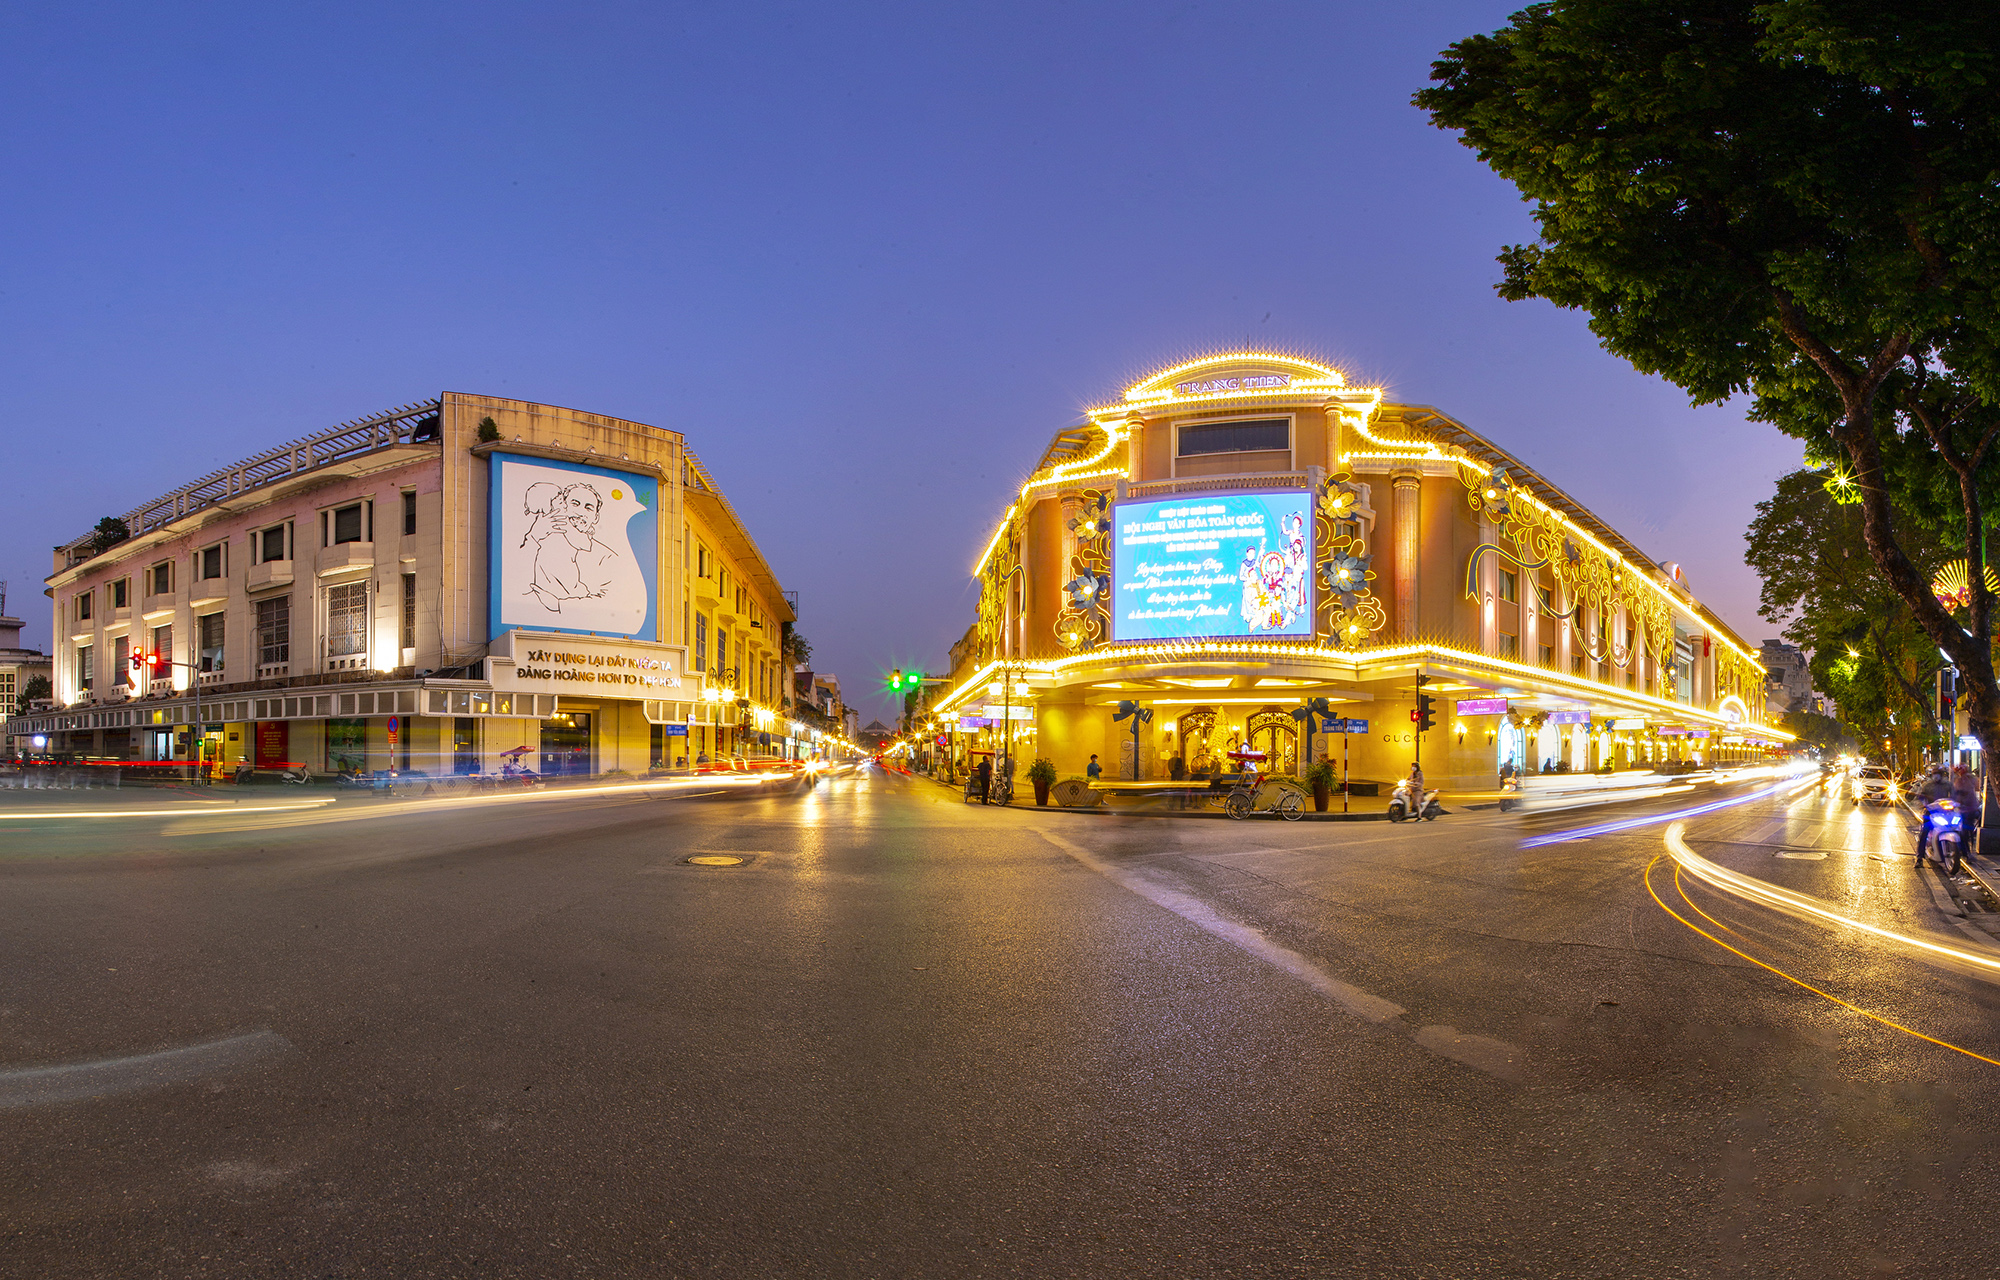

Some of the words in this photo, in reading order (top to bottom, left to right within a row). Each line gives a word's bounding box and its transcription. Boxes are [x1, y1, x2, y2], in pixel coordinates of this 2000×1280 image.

[1176, 377, 1240, 394] TRANG
[1242, 375, 1291, 389] TIEN
[1123, 521, 1141, 534] HỘI
[1142, 521, 1166, 533] NGHỊ
[1167, 518, 1186, 530] VĂN
[1187, 516, 1208, 528] HÓA
[1208, 514, 1235, 527] TOÀN
[1236, 512, 1264, 526] QUỐC
[528, 649, 552, 662] XÂY
[554, 652, 586, 665] DỤNG
[589, 654, 604, 667] LẠI
[606, 653, 627, 667] ĐẤT
[660, 661, 672, 671] TA
[554, 668, 596, 682] HOÀNG
[597, 672, 621, 684] HƠN
[623, 674, 637, 685] TO
[1383, 734, 1426, 743] GUCCI
